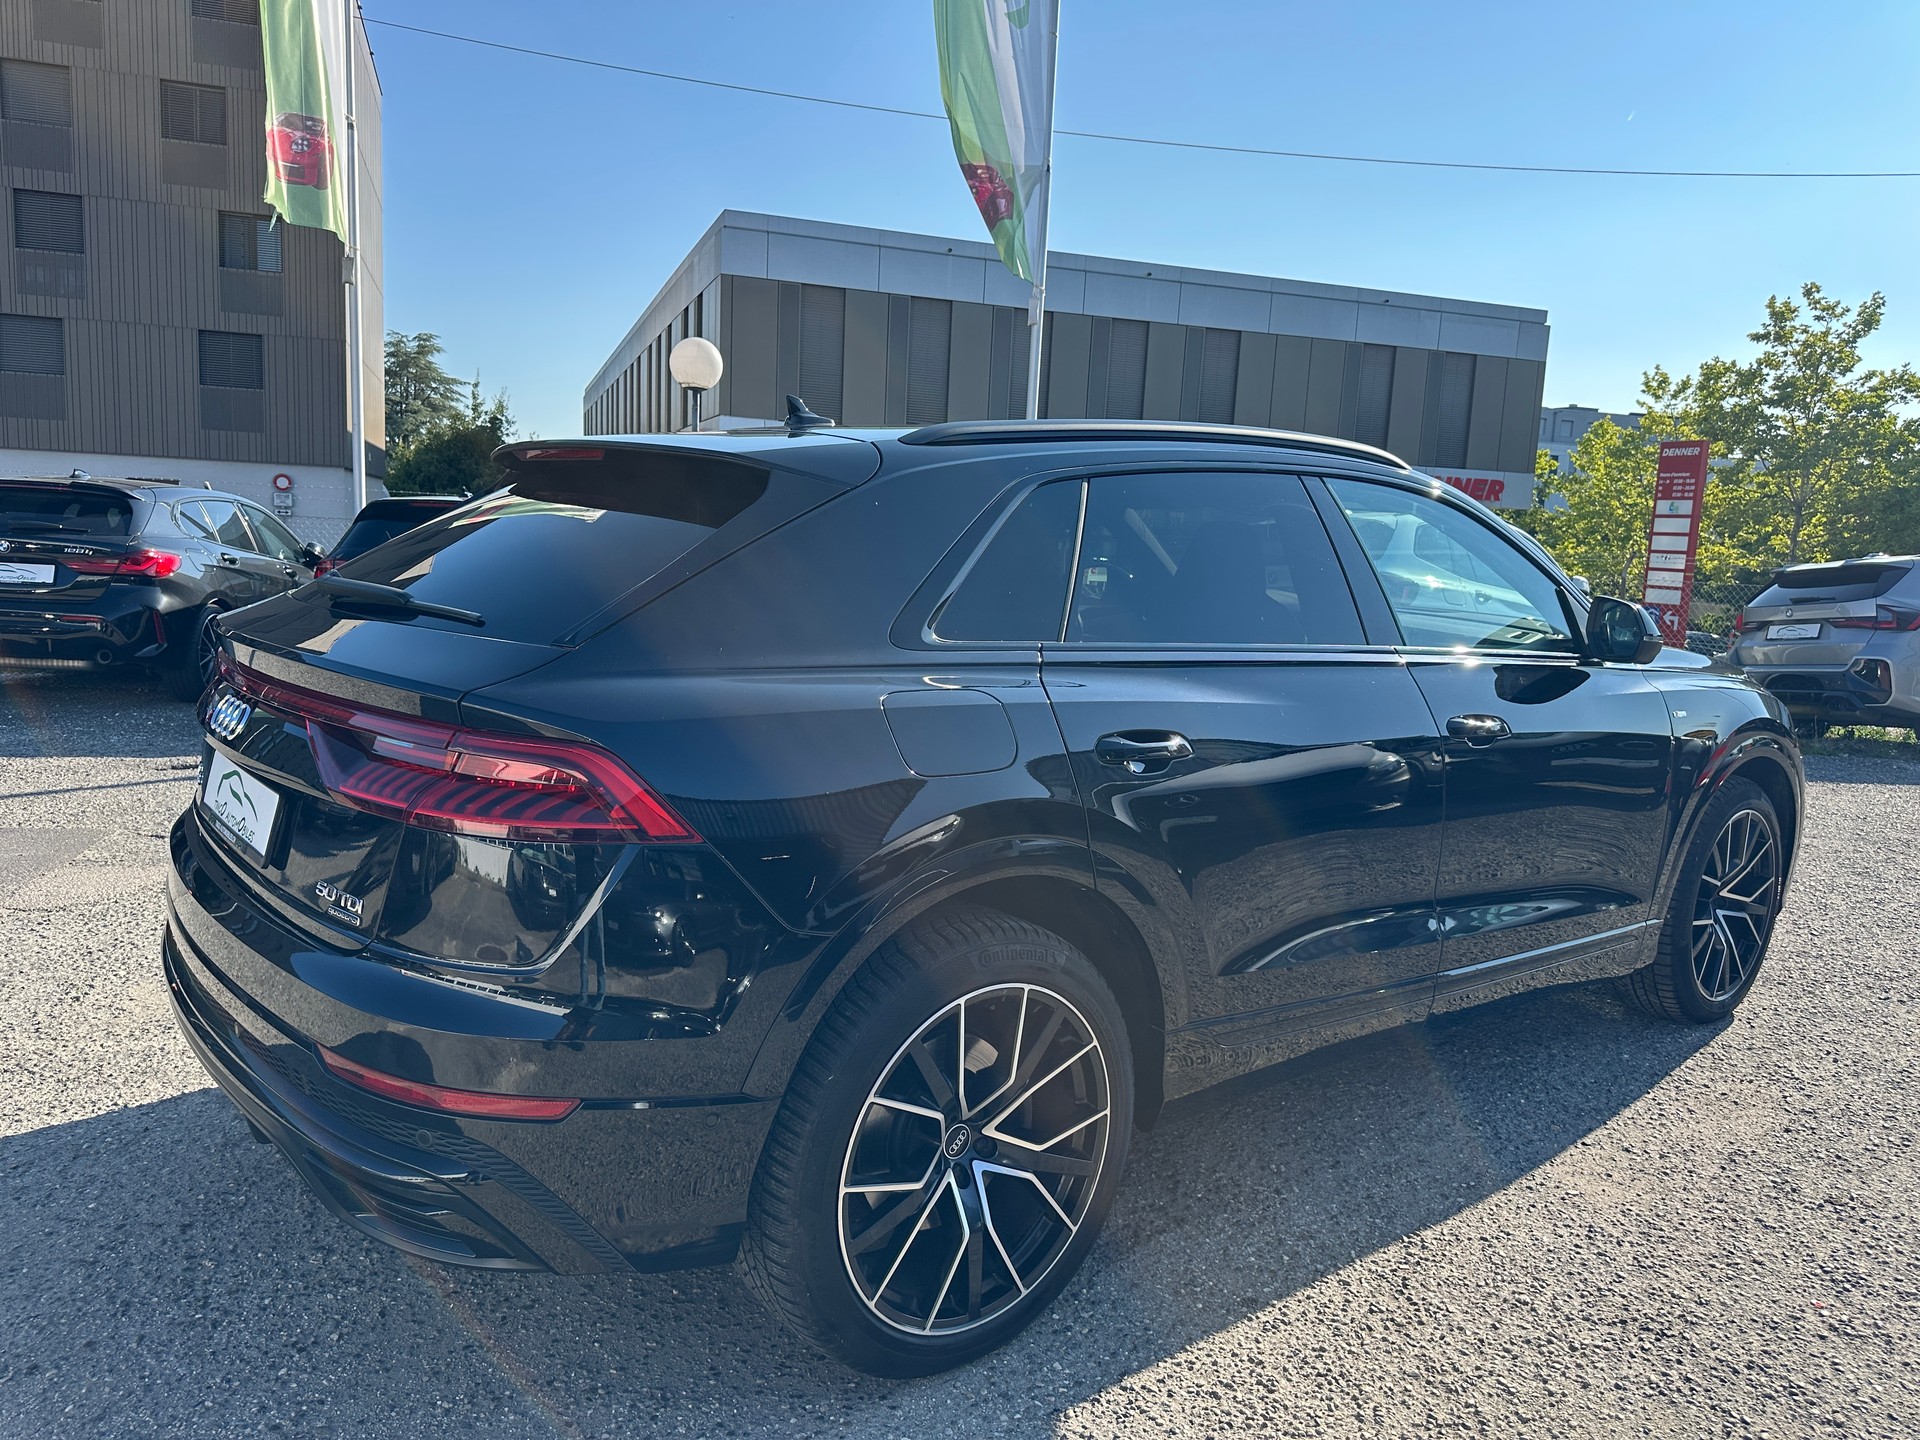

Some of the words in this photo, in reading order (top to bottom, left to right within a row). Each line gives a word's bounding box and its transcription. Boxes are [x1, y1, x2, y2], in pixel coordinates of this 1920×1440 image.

[1662, 447, 1700, 457] DENNER
[225, 812, 256, 844] AUTOMOBILES
[328, 907, 359, 925] quattro
[978, 945, 1049, 967] Continental
